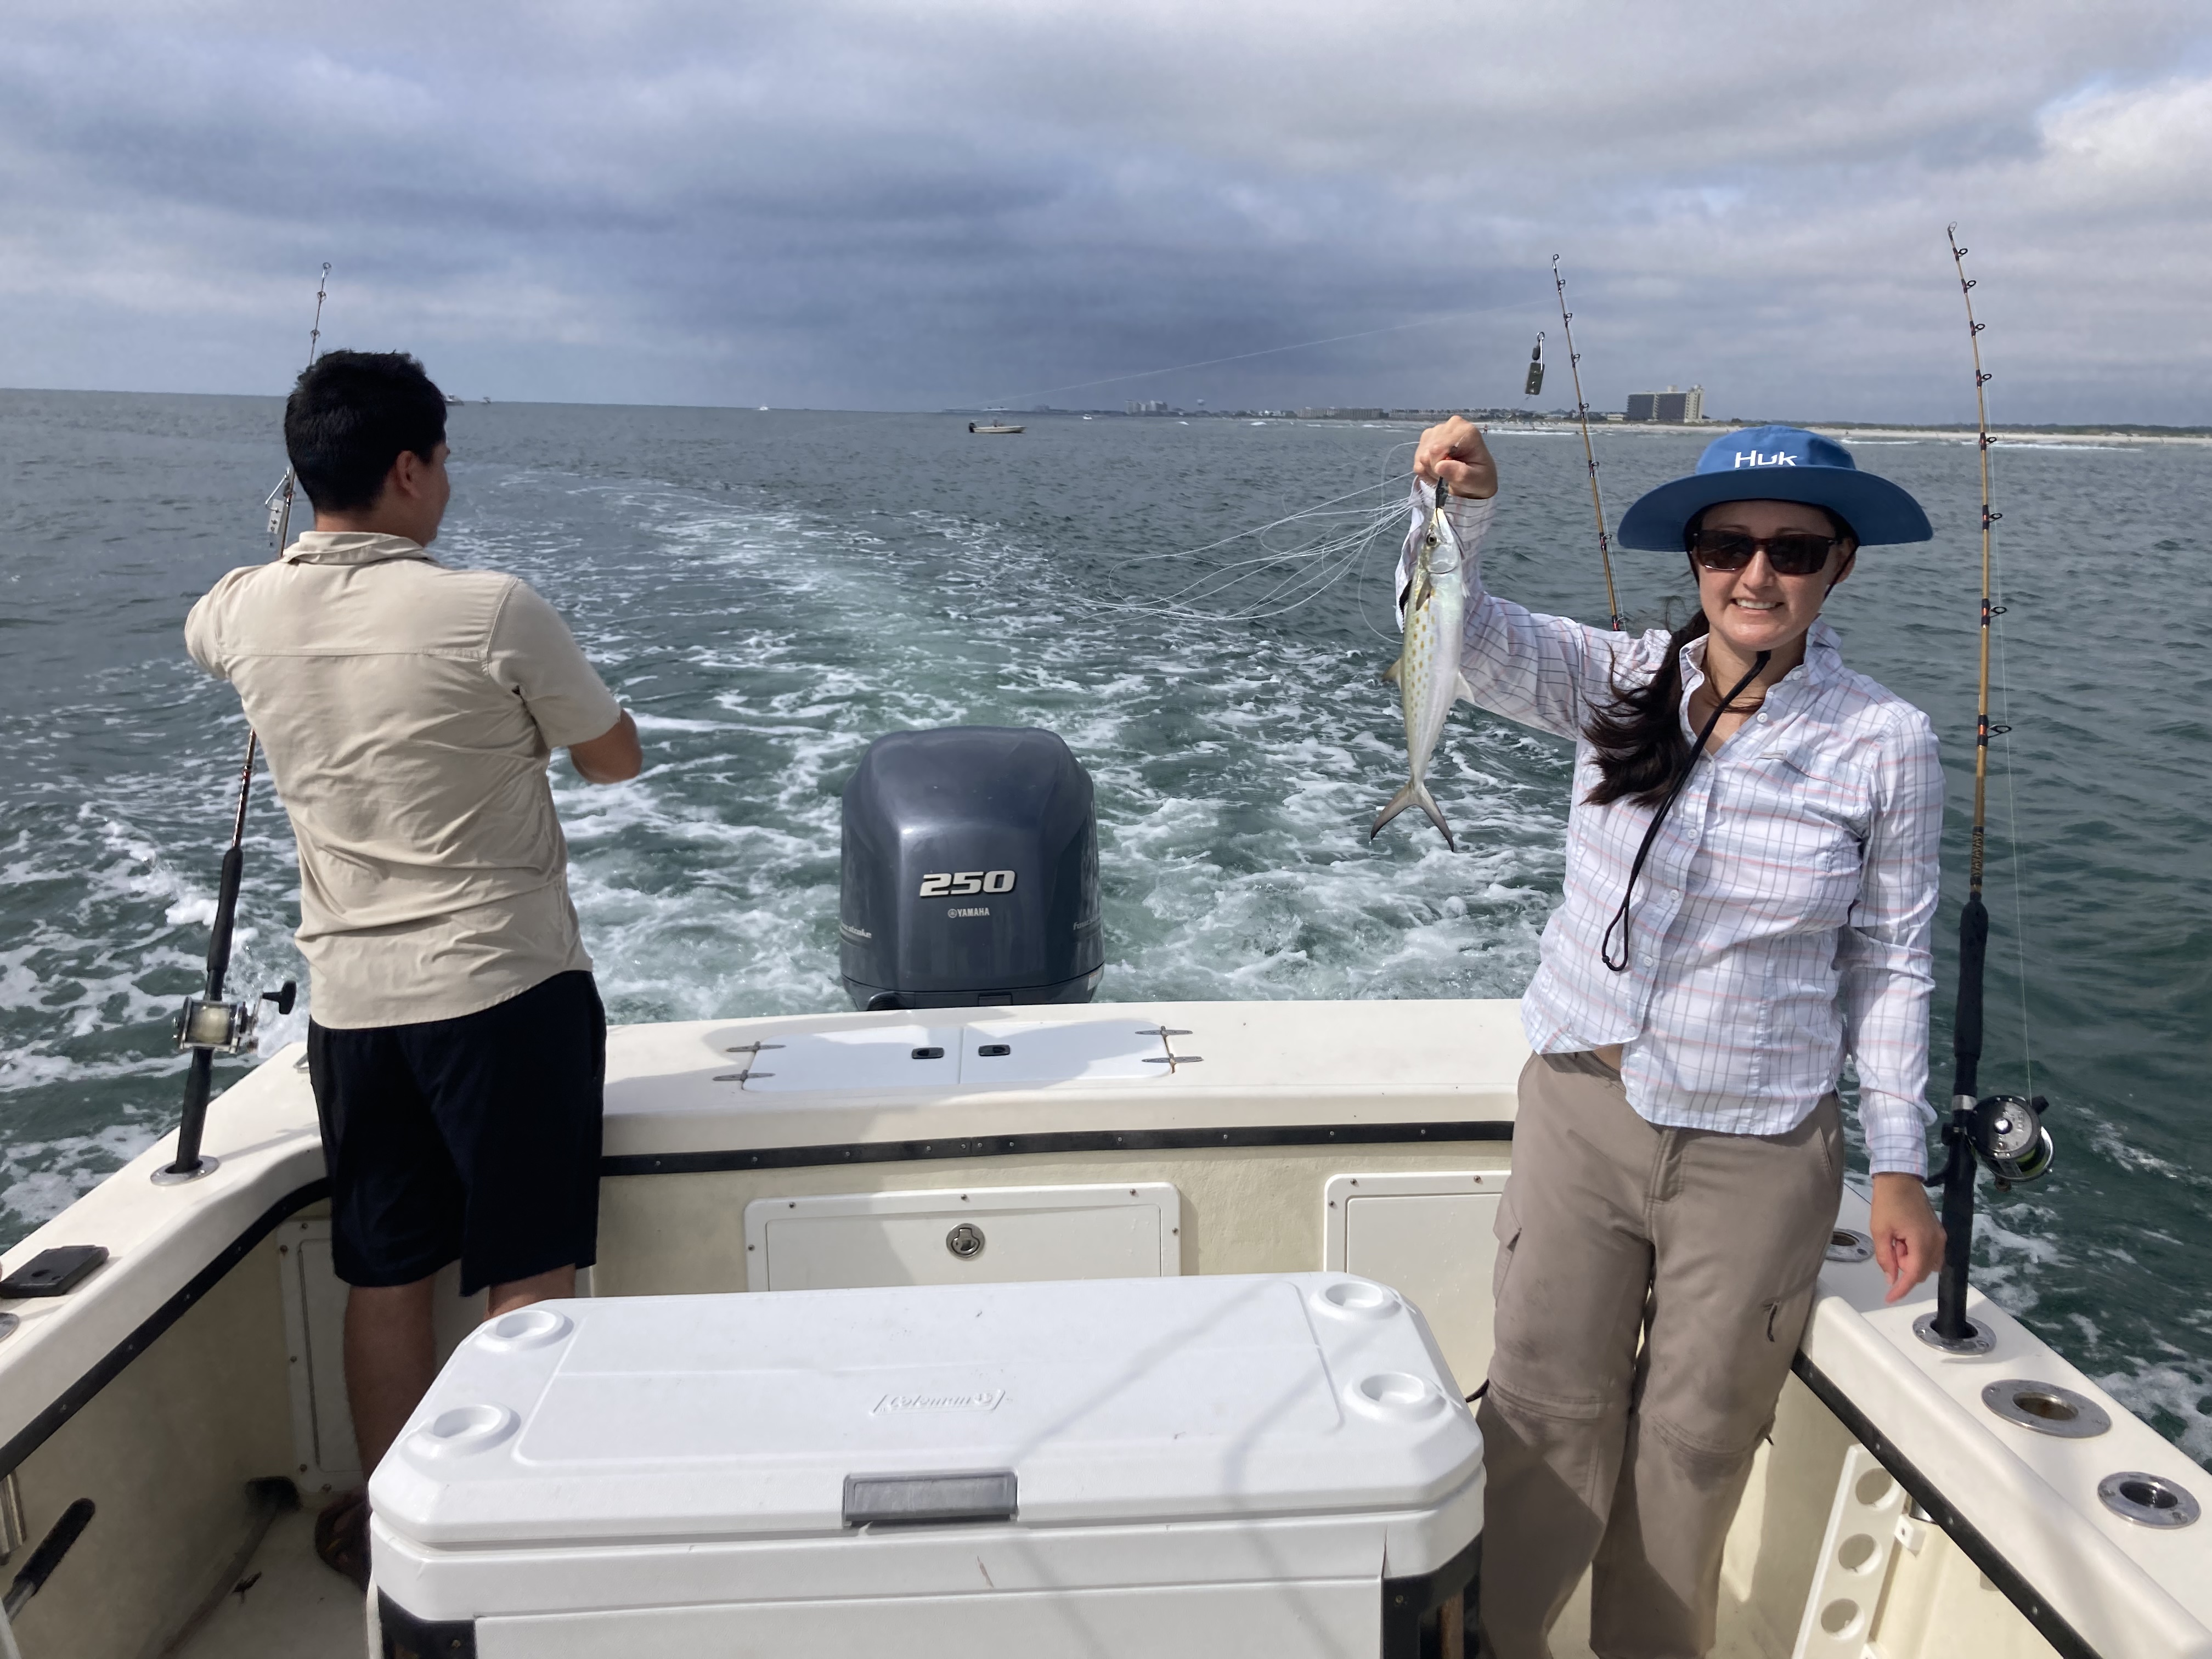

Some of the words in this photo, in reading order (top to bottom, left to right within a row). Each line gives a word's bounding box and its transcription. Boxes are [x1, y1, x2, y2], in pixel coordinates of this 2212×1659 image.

[1735, 450, 1797, 468] Huk
[919, 870, 1016, 897] 250
[957, 907, 990, 917] YAMAHA
[888, 1395, 972, 1408] Coleman
